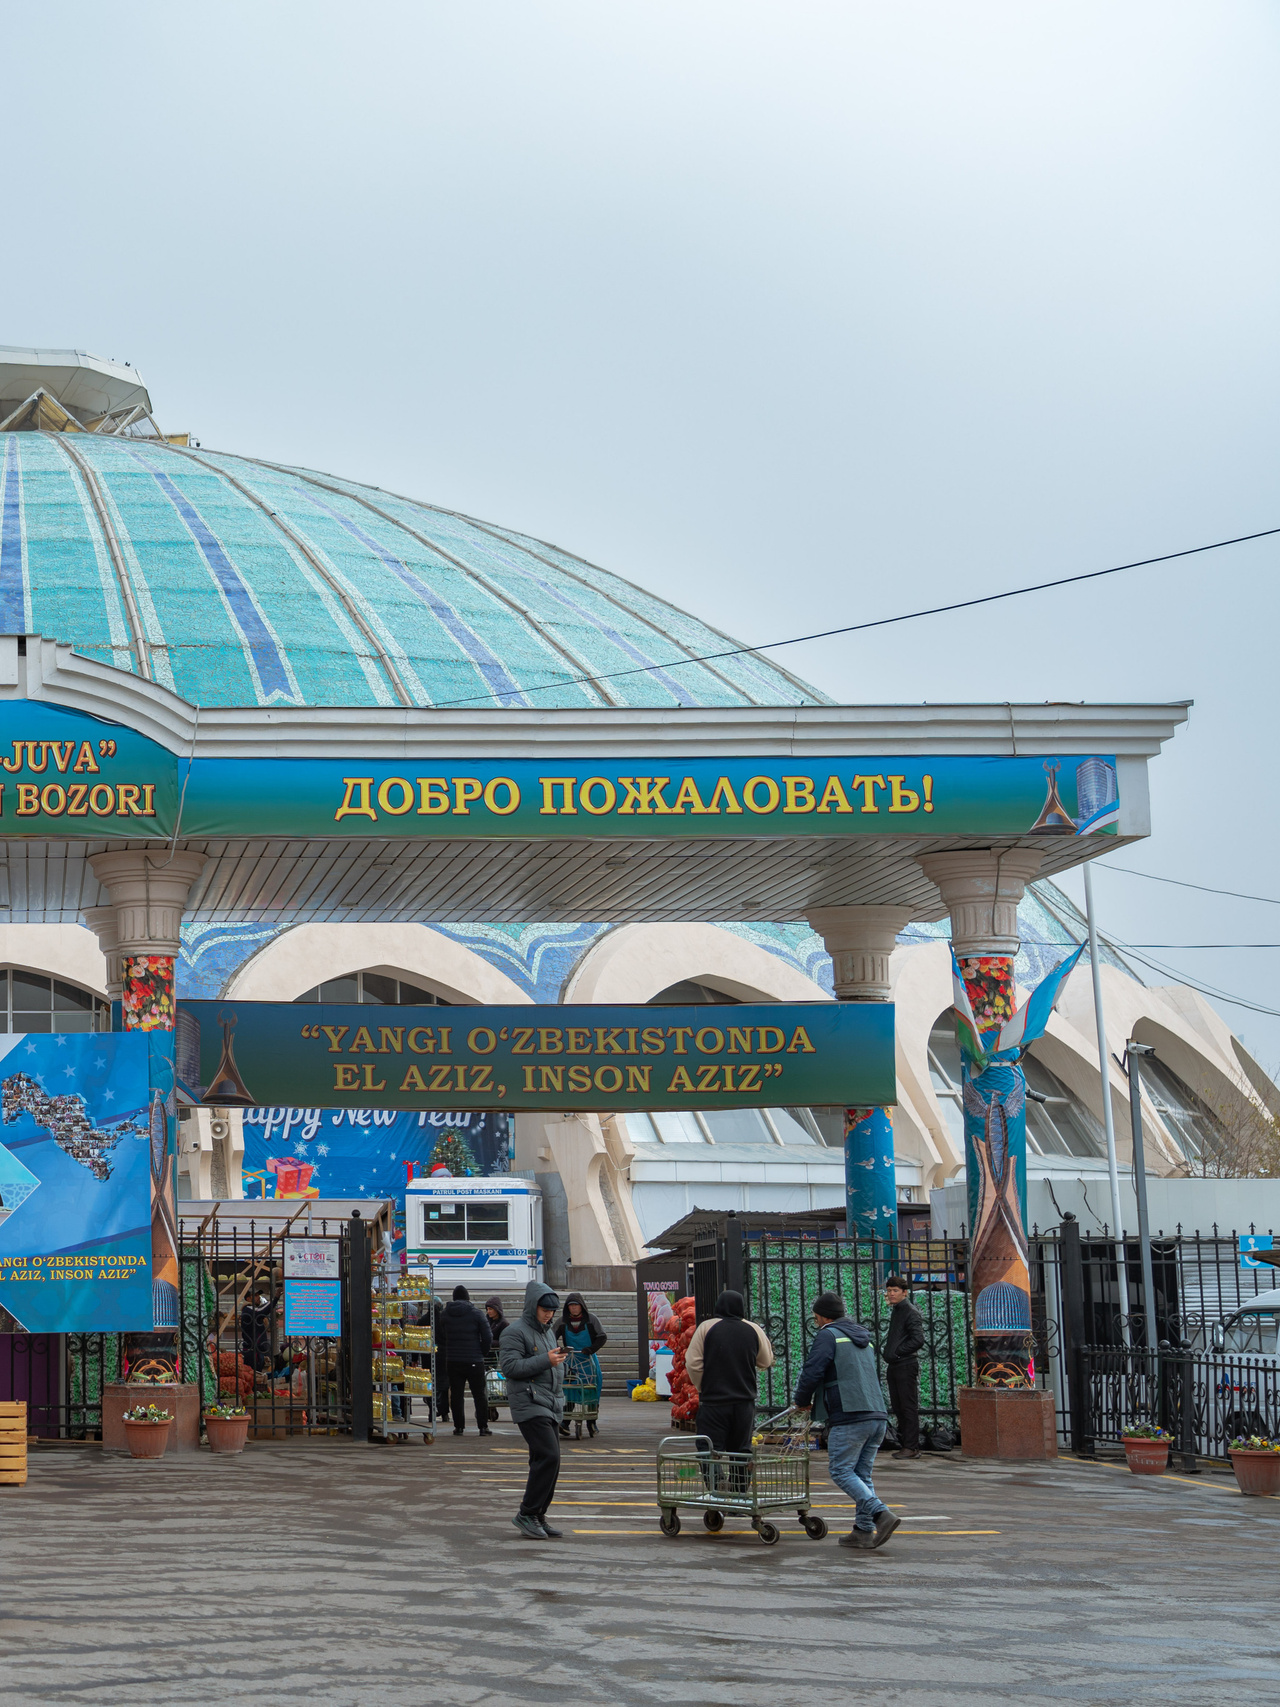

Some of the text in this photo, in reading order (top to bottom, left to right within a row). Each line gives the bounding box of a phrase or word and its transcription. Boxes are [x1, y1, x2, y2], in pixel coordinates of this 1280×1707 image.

[16, 783, 157, 817] BOZORI
[334, 773, 936, 822] ДОБРО ПОЖАЛОВАТЬ!
[300, 1025, 817, 1056] “YANGI O‘ZBEKISTONDA
[332, 1062, 784, 1098] EL AZIZ, INSON AZIZ”
[243, 1108, 323, 1140] appy
[11, 1269, 46, 1283] AZIZ,
[50, 1269, 94, 1281] INSON
[98, 1268, 137, 1281] AZIZ”
[32, 1256, 147, 1268] O‘ZBEKISTONDA
